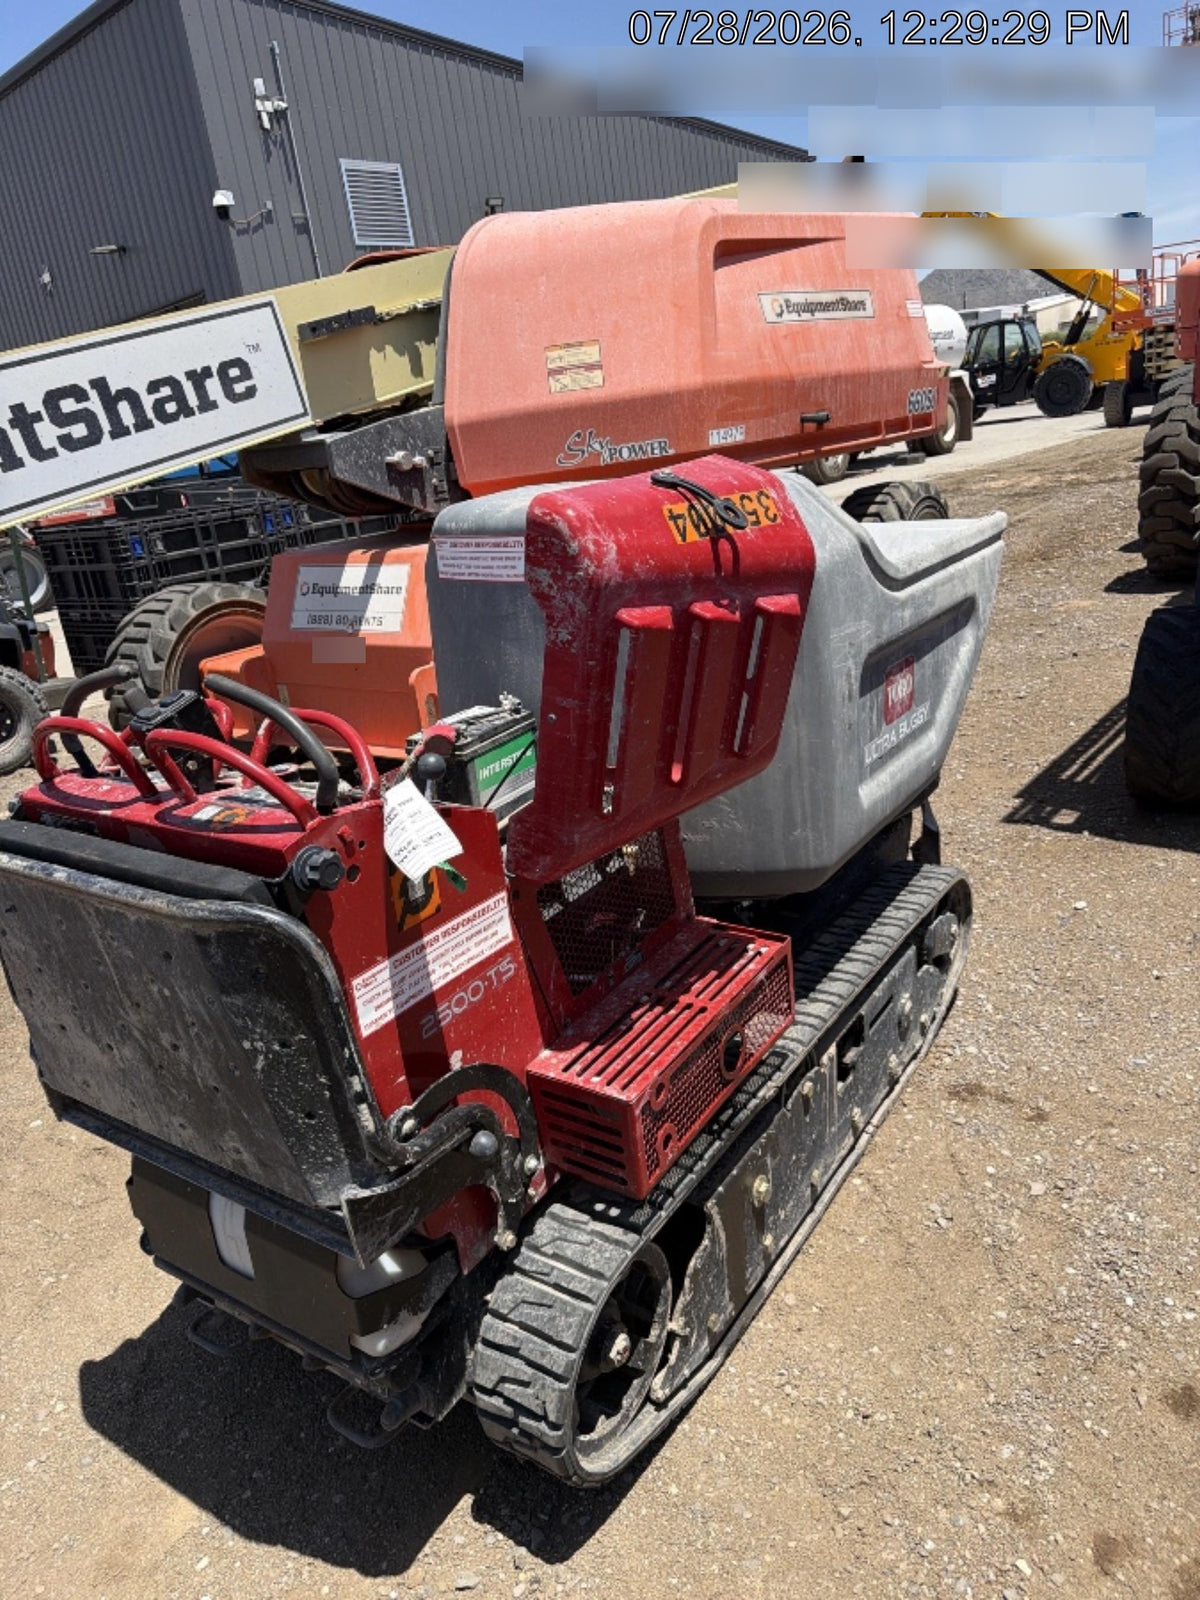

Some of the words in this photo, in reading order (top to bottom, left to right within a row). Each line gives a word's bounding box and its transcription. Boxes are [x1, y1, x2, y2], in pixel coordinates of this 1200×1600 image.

[784, 297, 867, 317] EquipmentShare
[605, 439, 670, 463] POWER
[311, 582, 402, 598] EquipmentShare
[886, 672, 913, 708] TORO
[864, 730, 897, 765] ULTRA
[899, 701, 930, 739] BUGGY
[392, 935, 440, 970] CUSTOMER
[441, 895, 507, 939] RESPONSIBILITY
